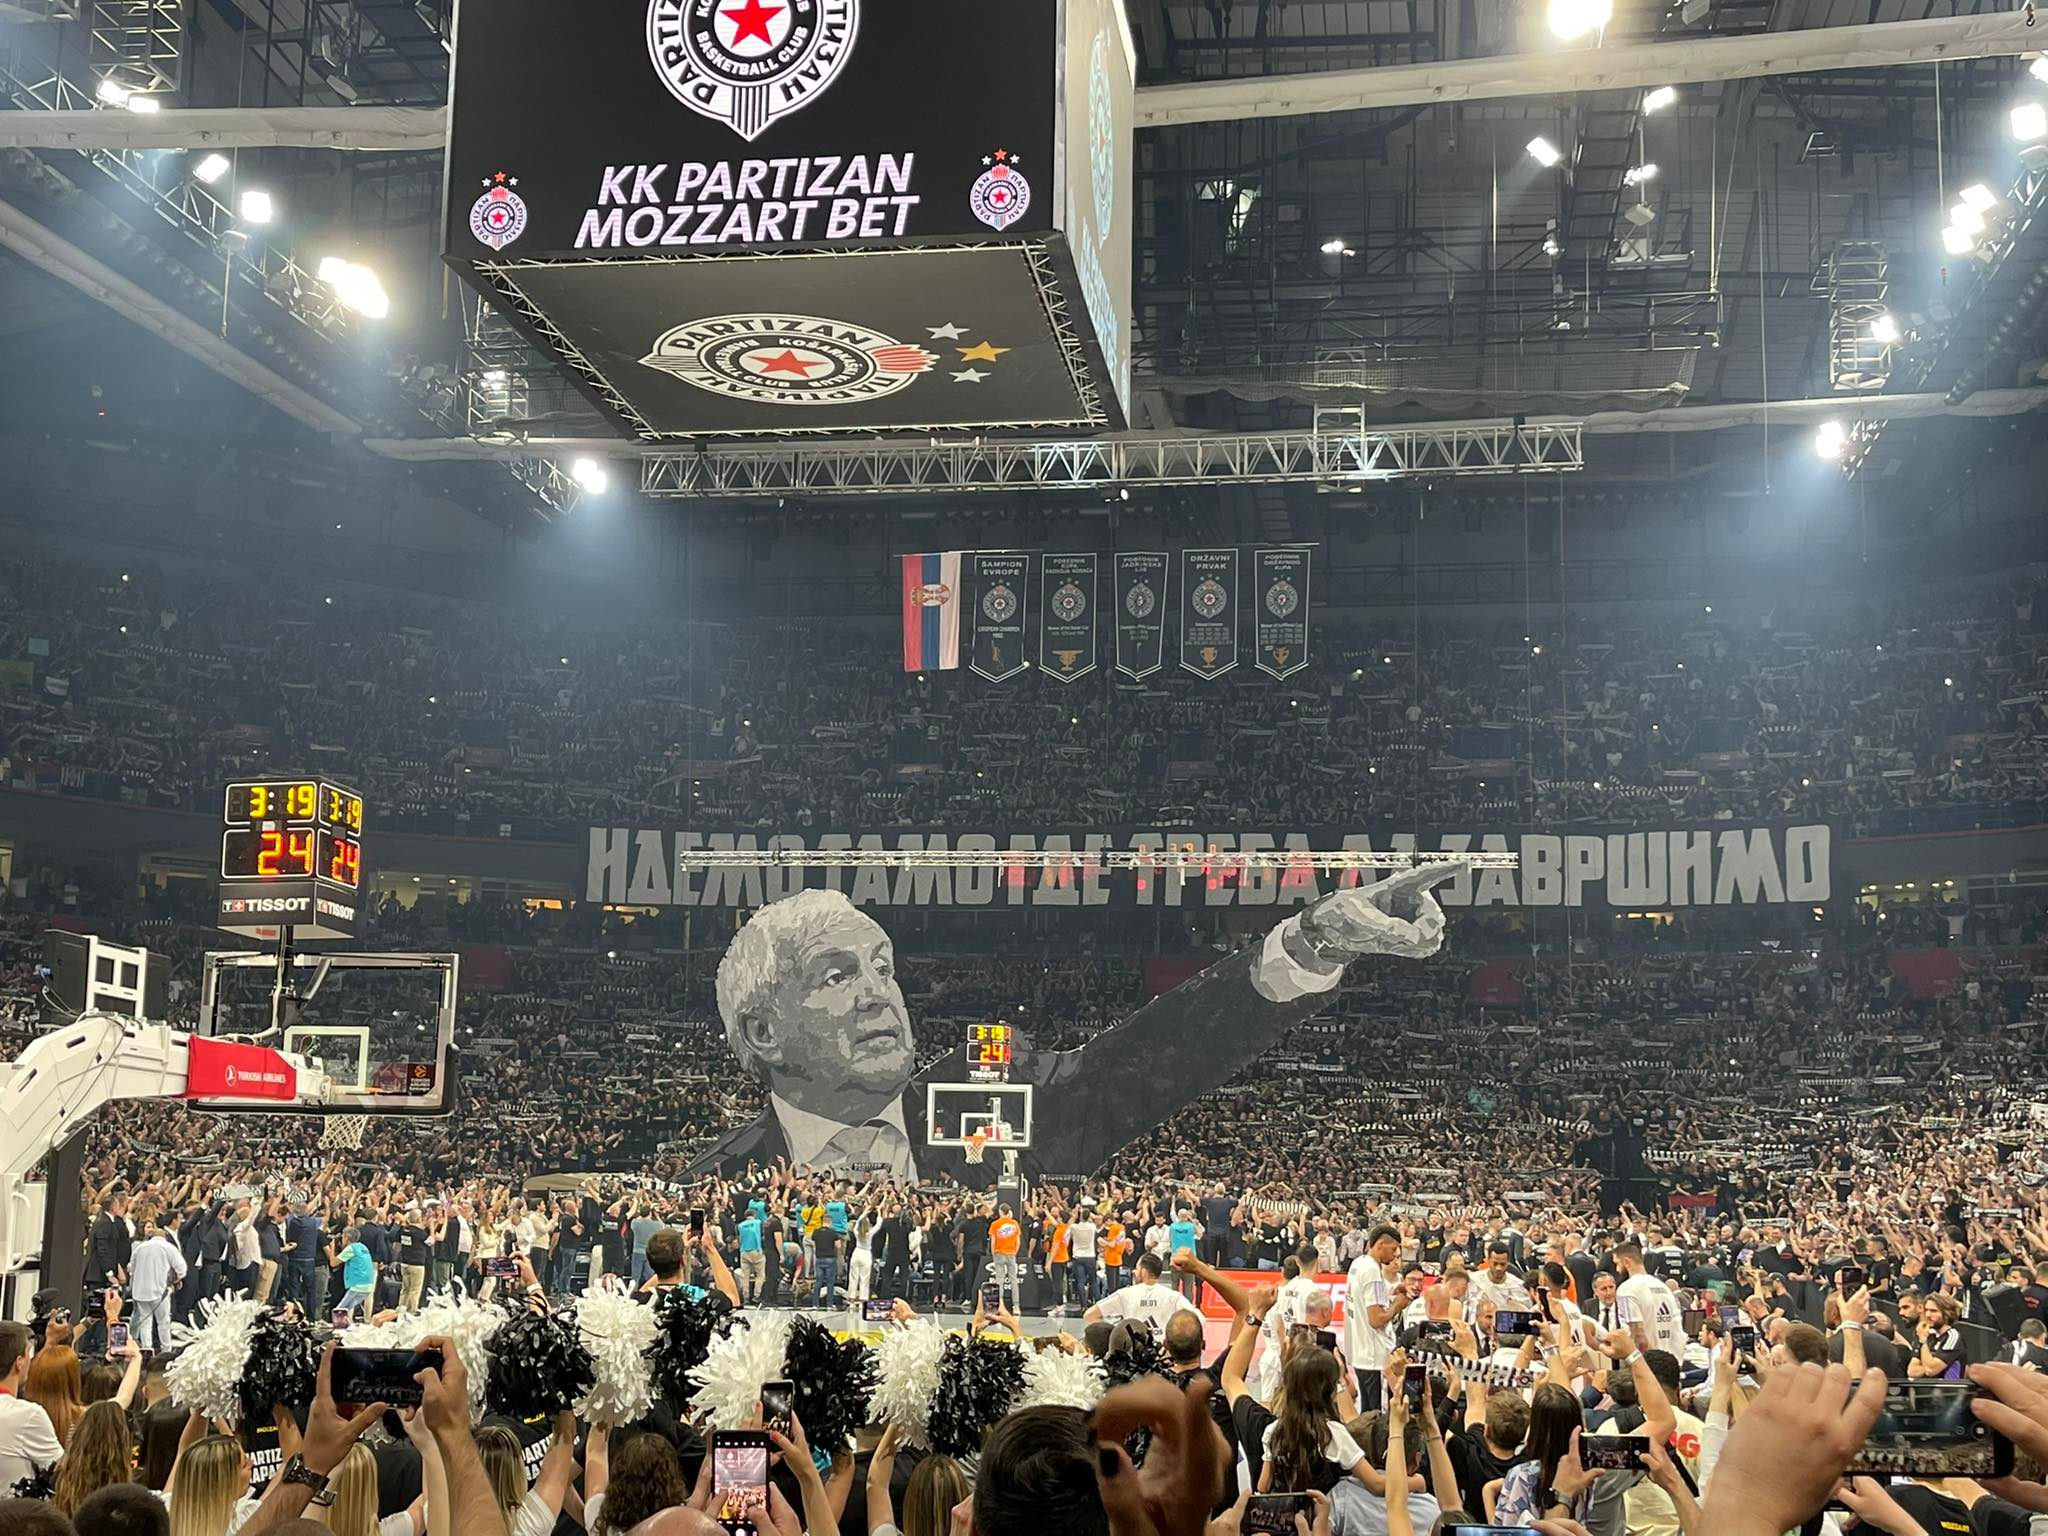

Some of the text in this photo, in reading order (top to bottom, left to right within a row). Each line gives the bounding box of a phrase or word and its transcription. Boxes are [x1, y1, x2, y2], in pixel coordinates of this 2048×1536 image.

[696, 26, 809, 76] BASKETBALL CLUB
[780, 0, 848, 102] ТИЗАН
[598, 152, 914, 205] KK PARTIZAN
[574, 195, 920, 248] MOZZART BET
[668, 318, 872, 350] PARTIZAN
[743, 373, 791, 388] CLUB
[981, 560, 1022, 568] ŠAMPION
[1190, 554, 1230, 562] DRŽAVNI
[1196, 562, 1227, 570] PRVAK
[250, 785, 314, 818] 3:19
[257, 831, 313, 875] 24
[331, 838, 359, 885] 24
[818, 833, 996, 905] ТАМО
[1008, 834, 1113, 905] ГДЕ
[1129, 833, 1321, 906] ТРЕБА
[1438, 825, 1831, 907] ЗАВРШИМО
[245, 898, 310, 912] TISSOT
[328, 903, 355, 920] TISSOT
[976, 1025, 1005, 1040] 3:19
[980, 1044, 1003, 1063] 24
[238, 1070, 286, 1084] TURKISH AIRLINES
[969, 1070, 1000, 1078] TISSOT
[245, 1447, 283, 1466] ARTIZ
